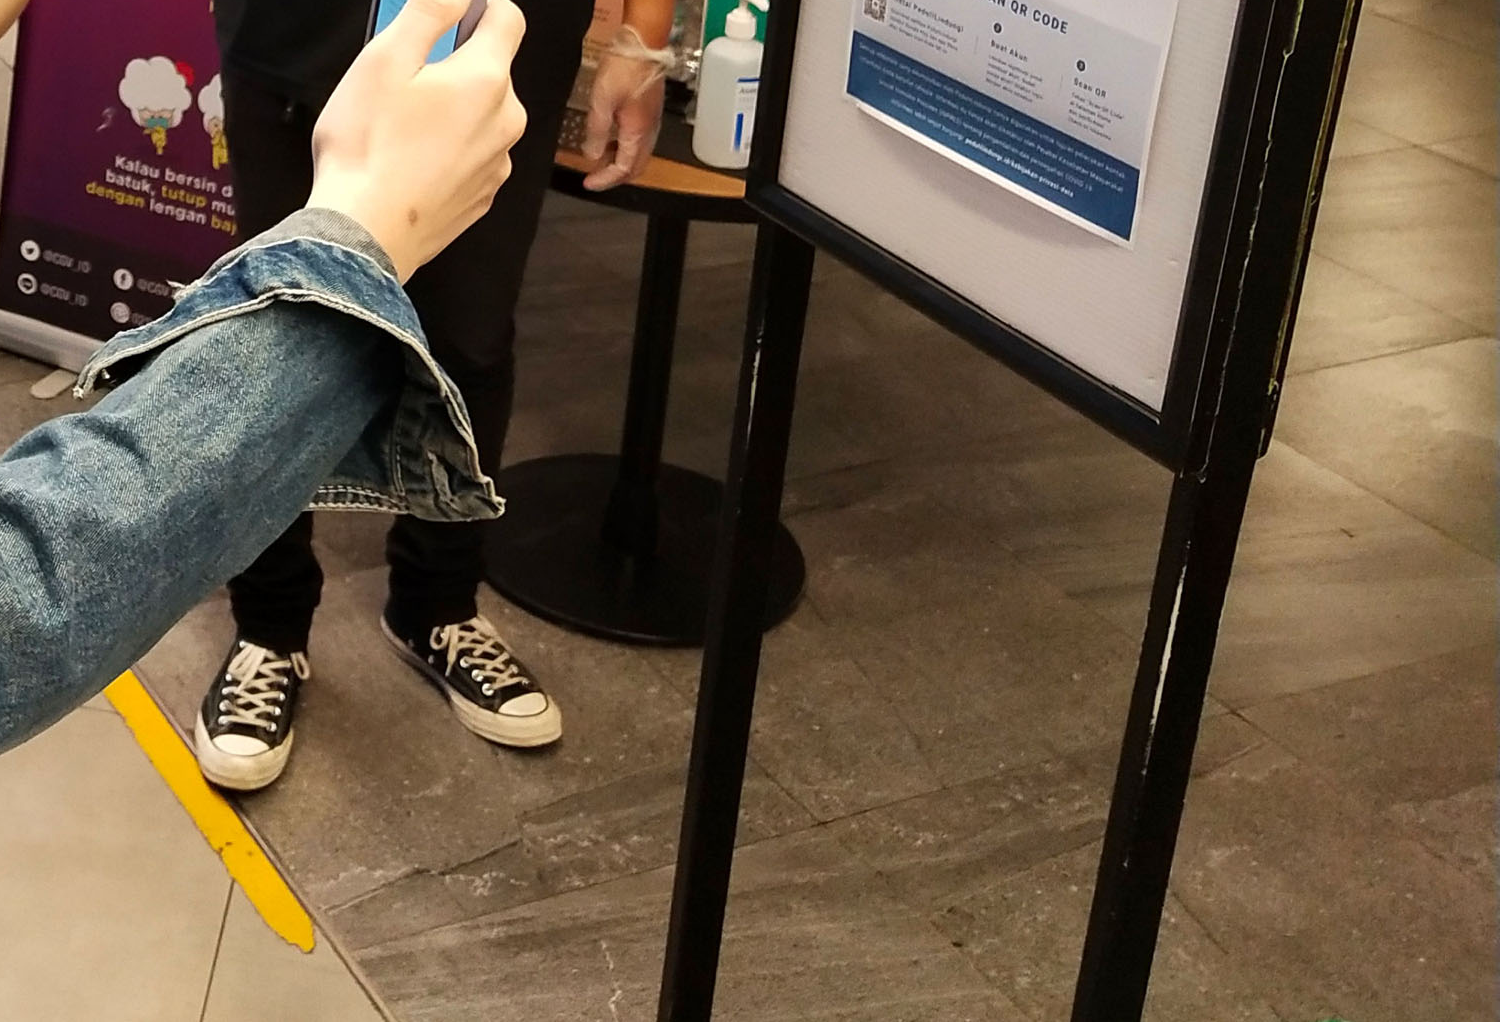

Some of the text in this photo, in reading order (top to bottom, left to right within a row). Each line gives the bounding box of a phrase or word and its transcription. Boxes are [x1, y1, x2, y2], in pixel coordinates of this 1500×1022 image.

[1010, 0, 1028, 17] QR
[1032, 9, 1068, 34] CODE
[1073, 77, 1107, 99] Scan QR
[105, 169, 156, 196] batuk,
[161, 185, 207, 208] tutup
[115, 155, 160, 178] Kalau
[165, 168, 217, 193] bersin
[85, 181, 145, 208] dengan
[149, 199, 207, 225] lengan
